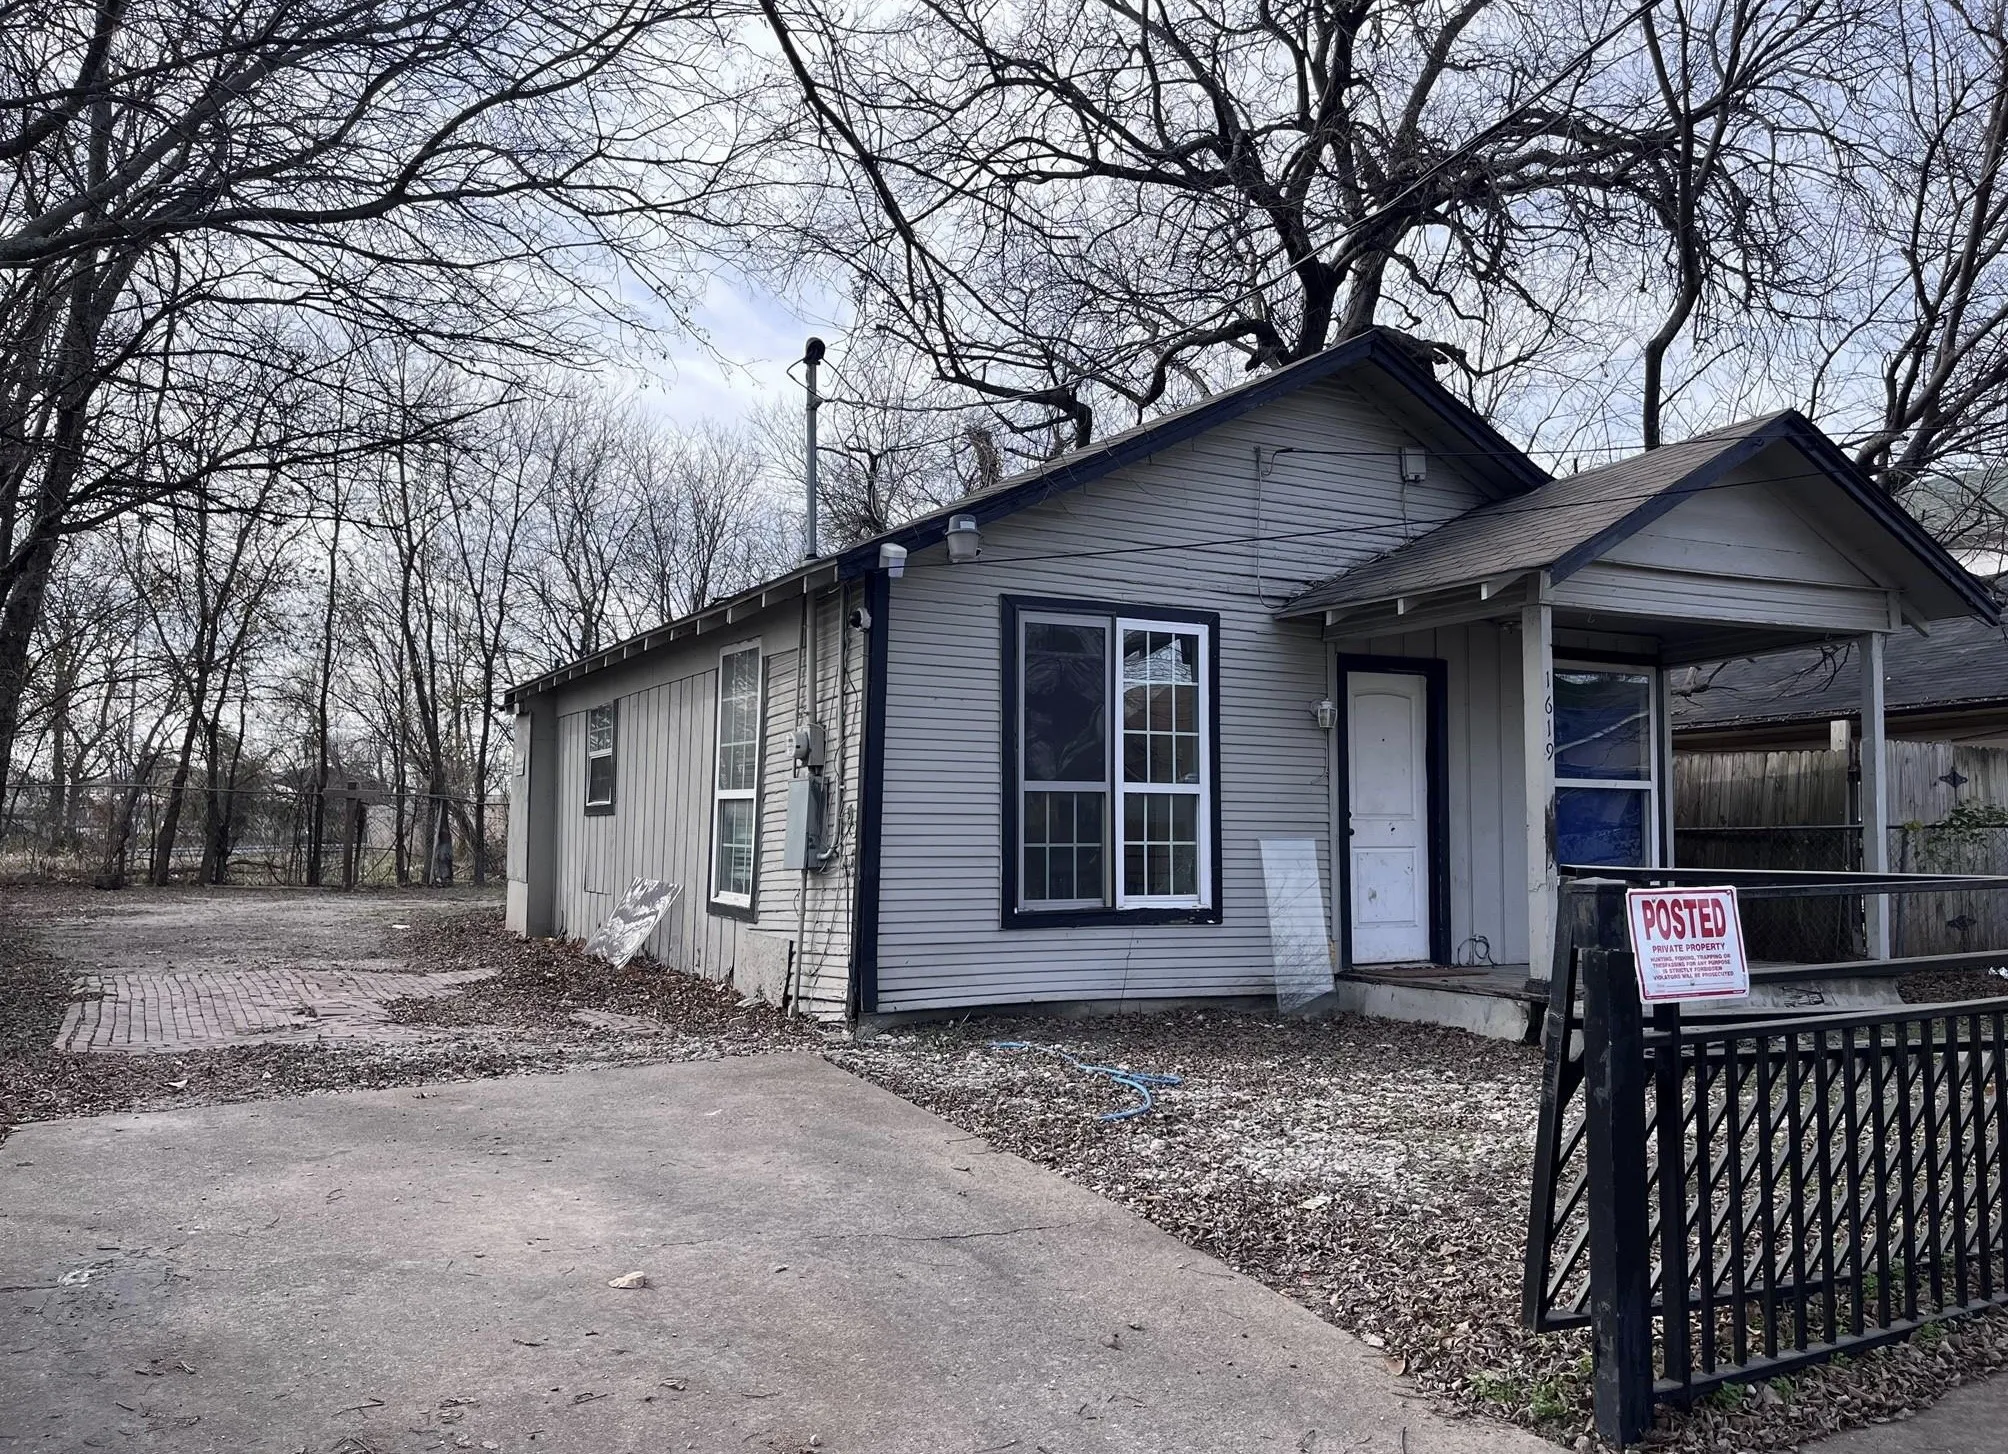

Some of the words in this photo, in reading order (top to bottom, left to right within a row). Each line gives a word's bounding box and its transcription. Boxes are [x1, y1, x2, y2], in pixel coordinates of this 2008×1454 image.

[1544, 671, 1554, 761] 1619
[1641, 898, 1726, 940] POSTED
[1652, 944, 1684, 953] PRIVATE
[1686, 942, 1725, 951] PROPERTY
